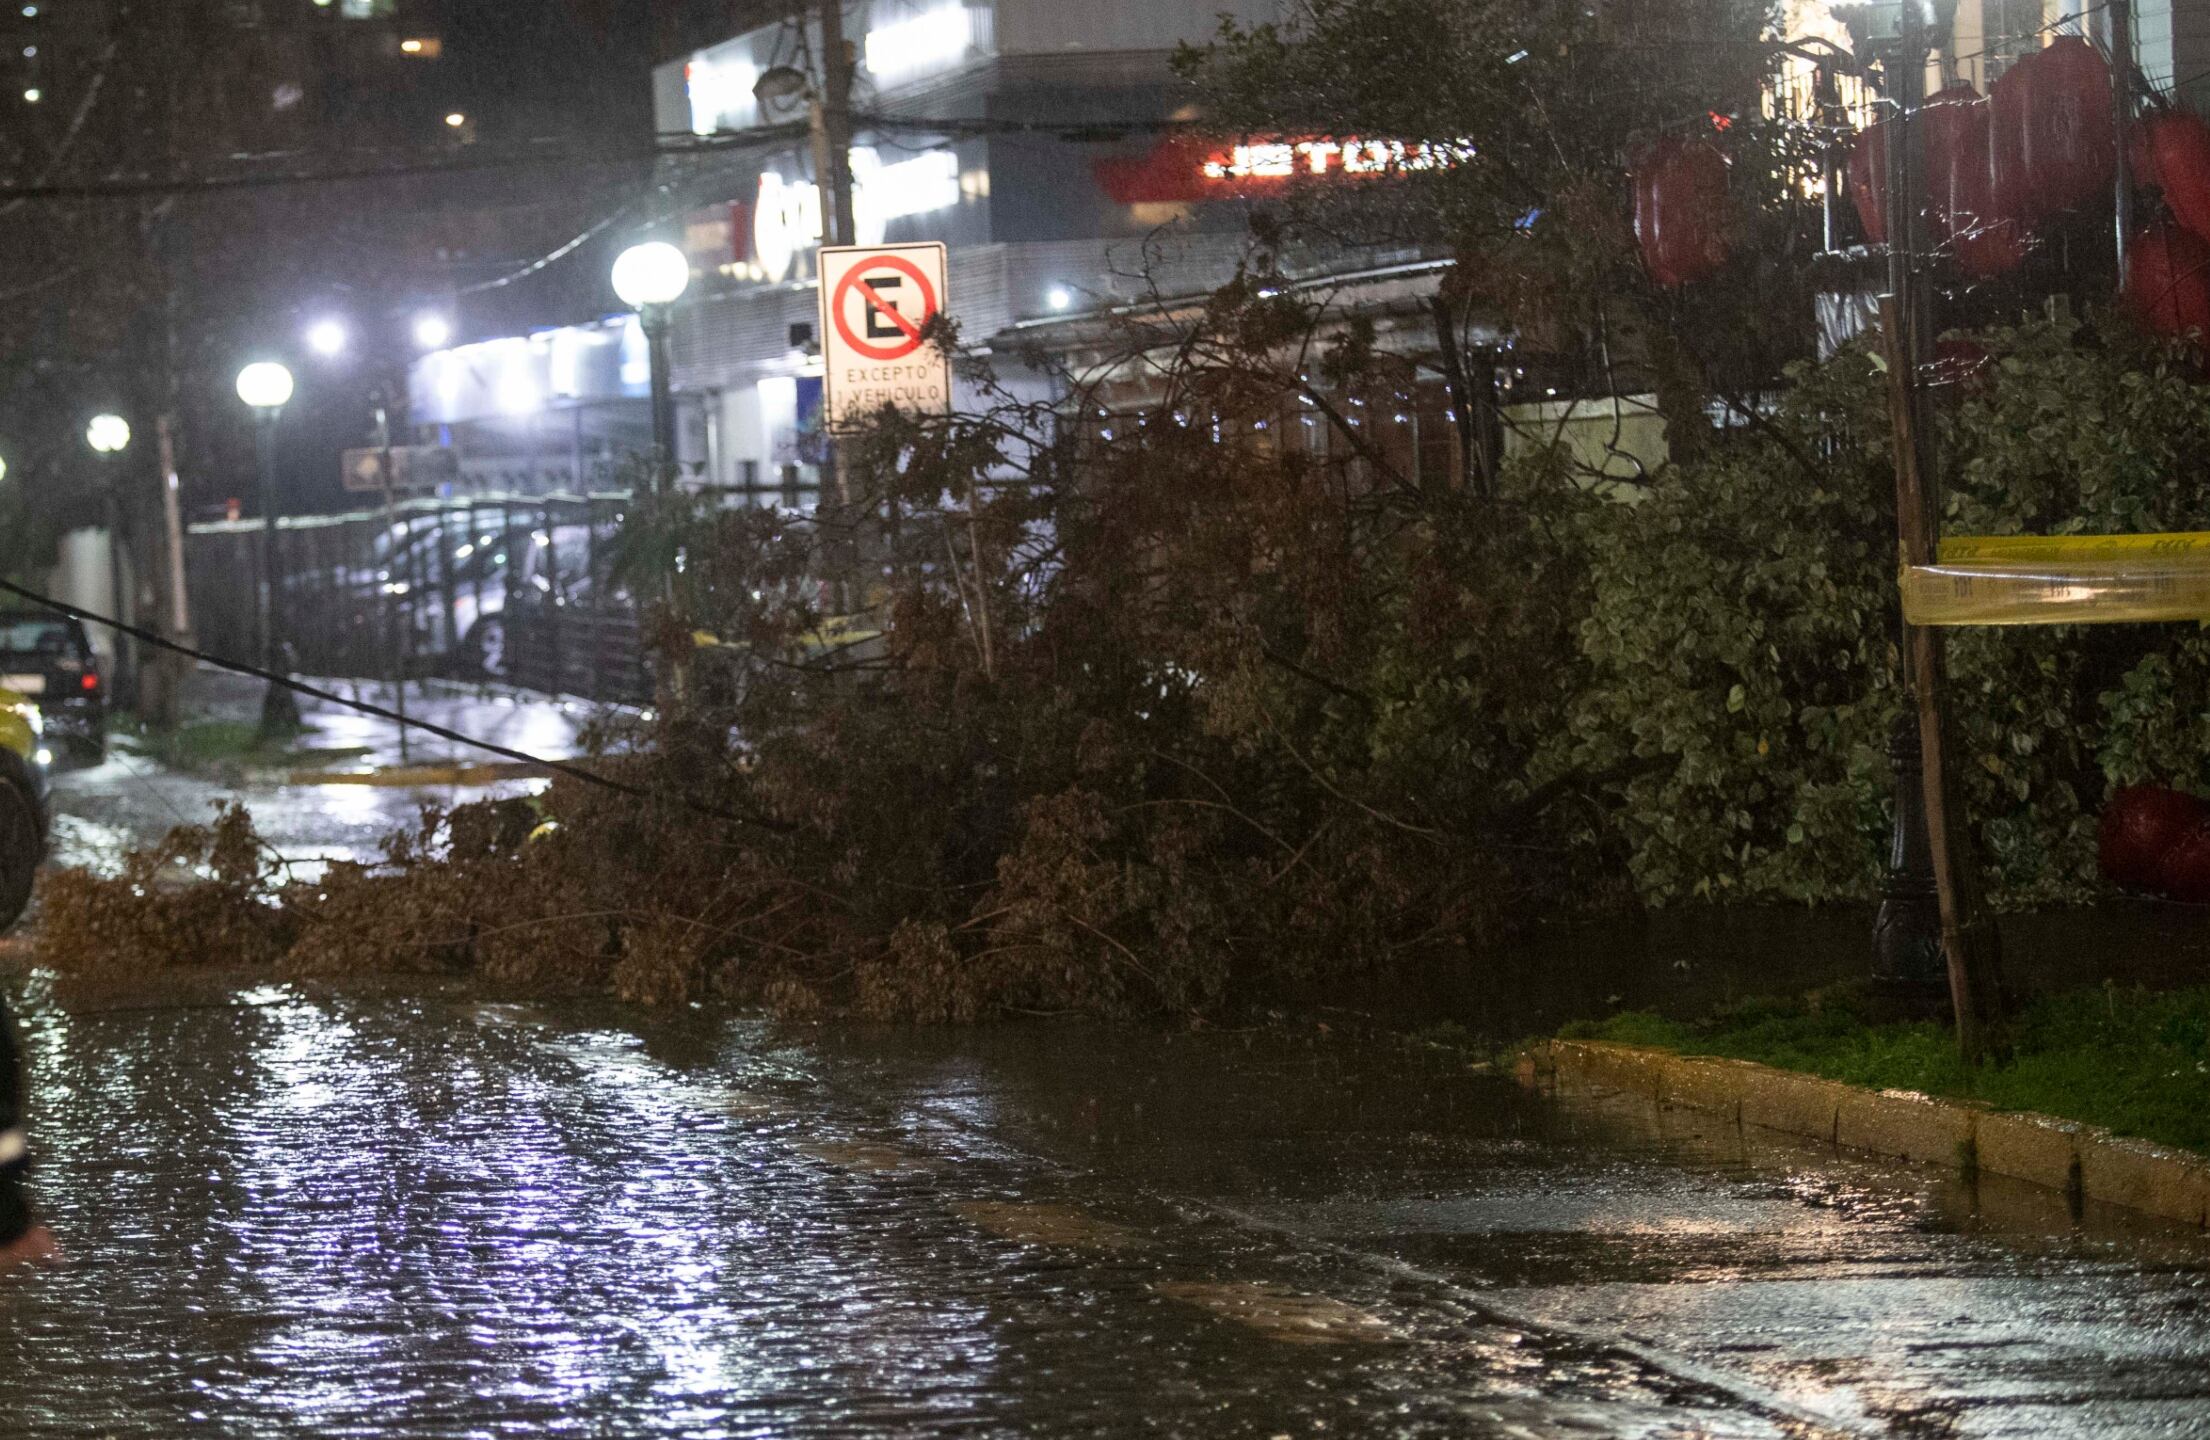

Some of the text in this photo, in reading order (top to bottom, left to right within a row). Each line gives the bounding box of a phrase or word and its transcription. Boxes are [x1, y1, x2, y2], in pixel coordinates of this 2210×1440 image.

[864, 276, 905, 338] E
[847, 366, 927, 383] EXCEPTO
[852, 386, 939, 403] VEHICULO
